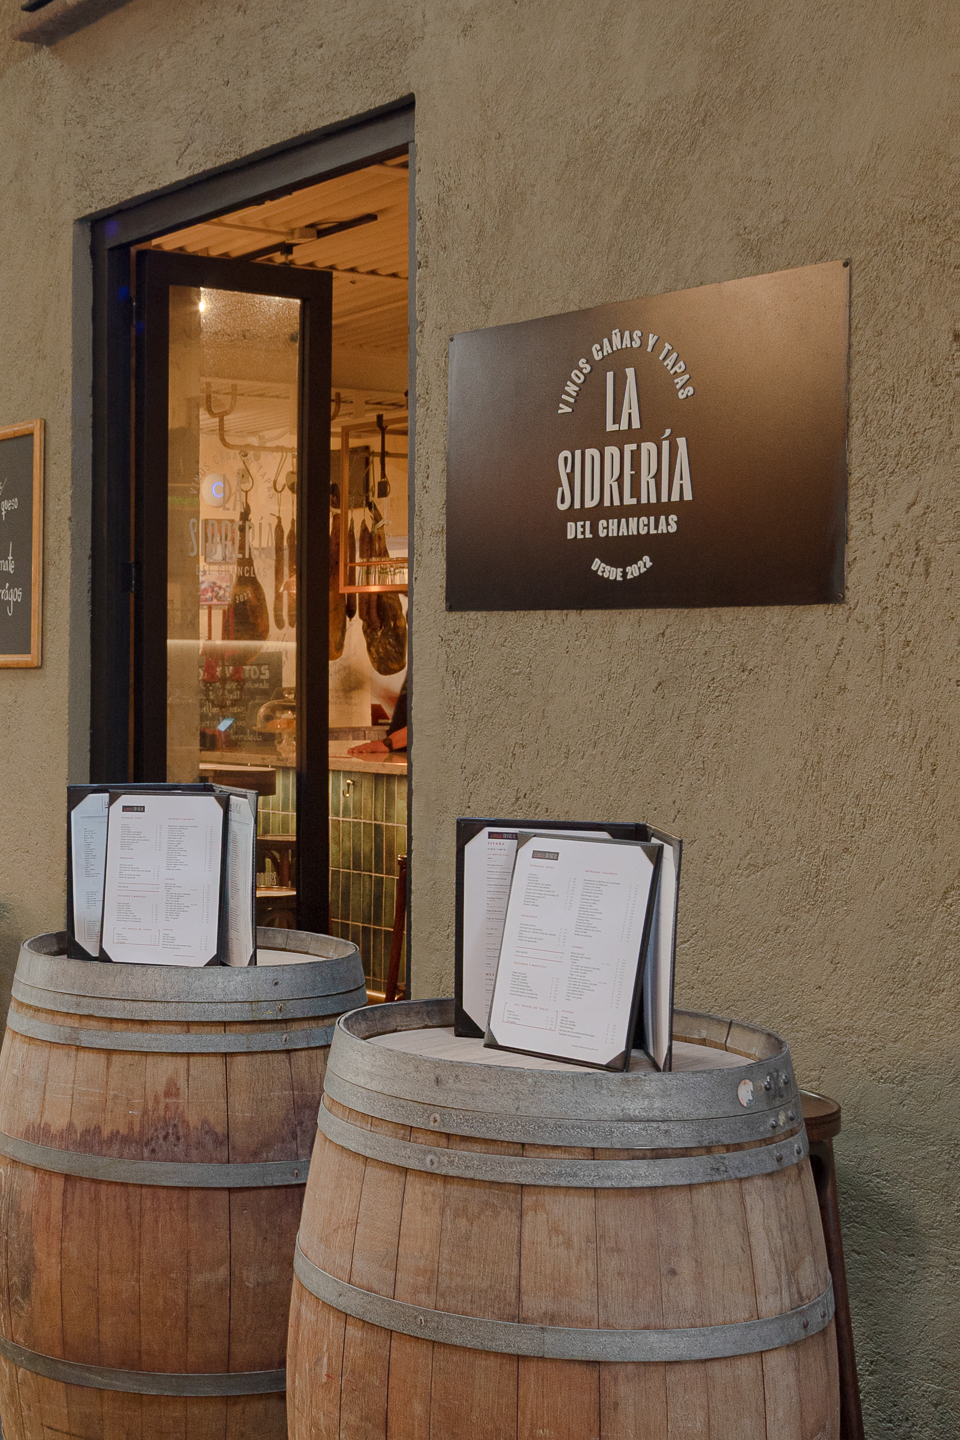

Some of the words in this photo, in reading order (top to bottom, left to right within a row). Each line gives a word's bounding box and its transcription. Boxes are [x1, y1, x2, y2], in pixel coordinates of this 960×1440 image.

[557, 358, 592, 414] VINOS
[591, 328, 642, 360] CAÑAS
[646, 334, 660, 353] Y
[658, 342, 695, 400] TAPAS
[606, 367, 640, 432] LA
[222, 469, 244, 512] LA
[556, 428, 693, 511] SIDRERÍA
[1, 498, 18, 520] queso
[566, 521, 592, 540] DEL
[598, 514, 678, 538] CHANCLAS
[591, 558, 623, 581] DESDE
[625, 555, 653, 579] 2022
